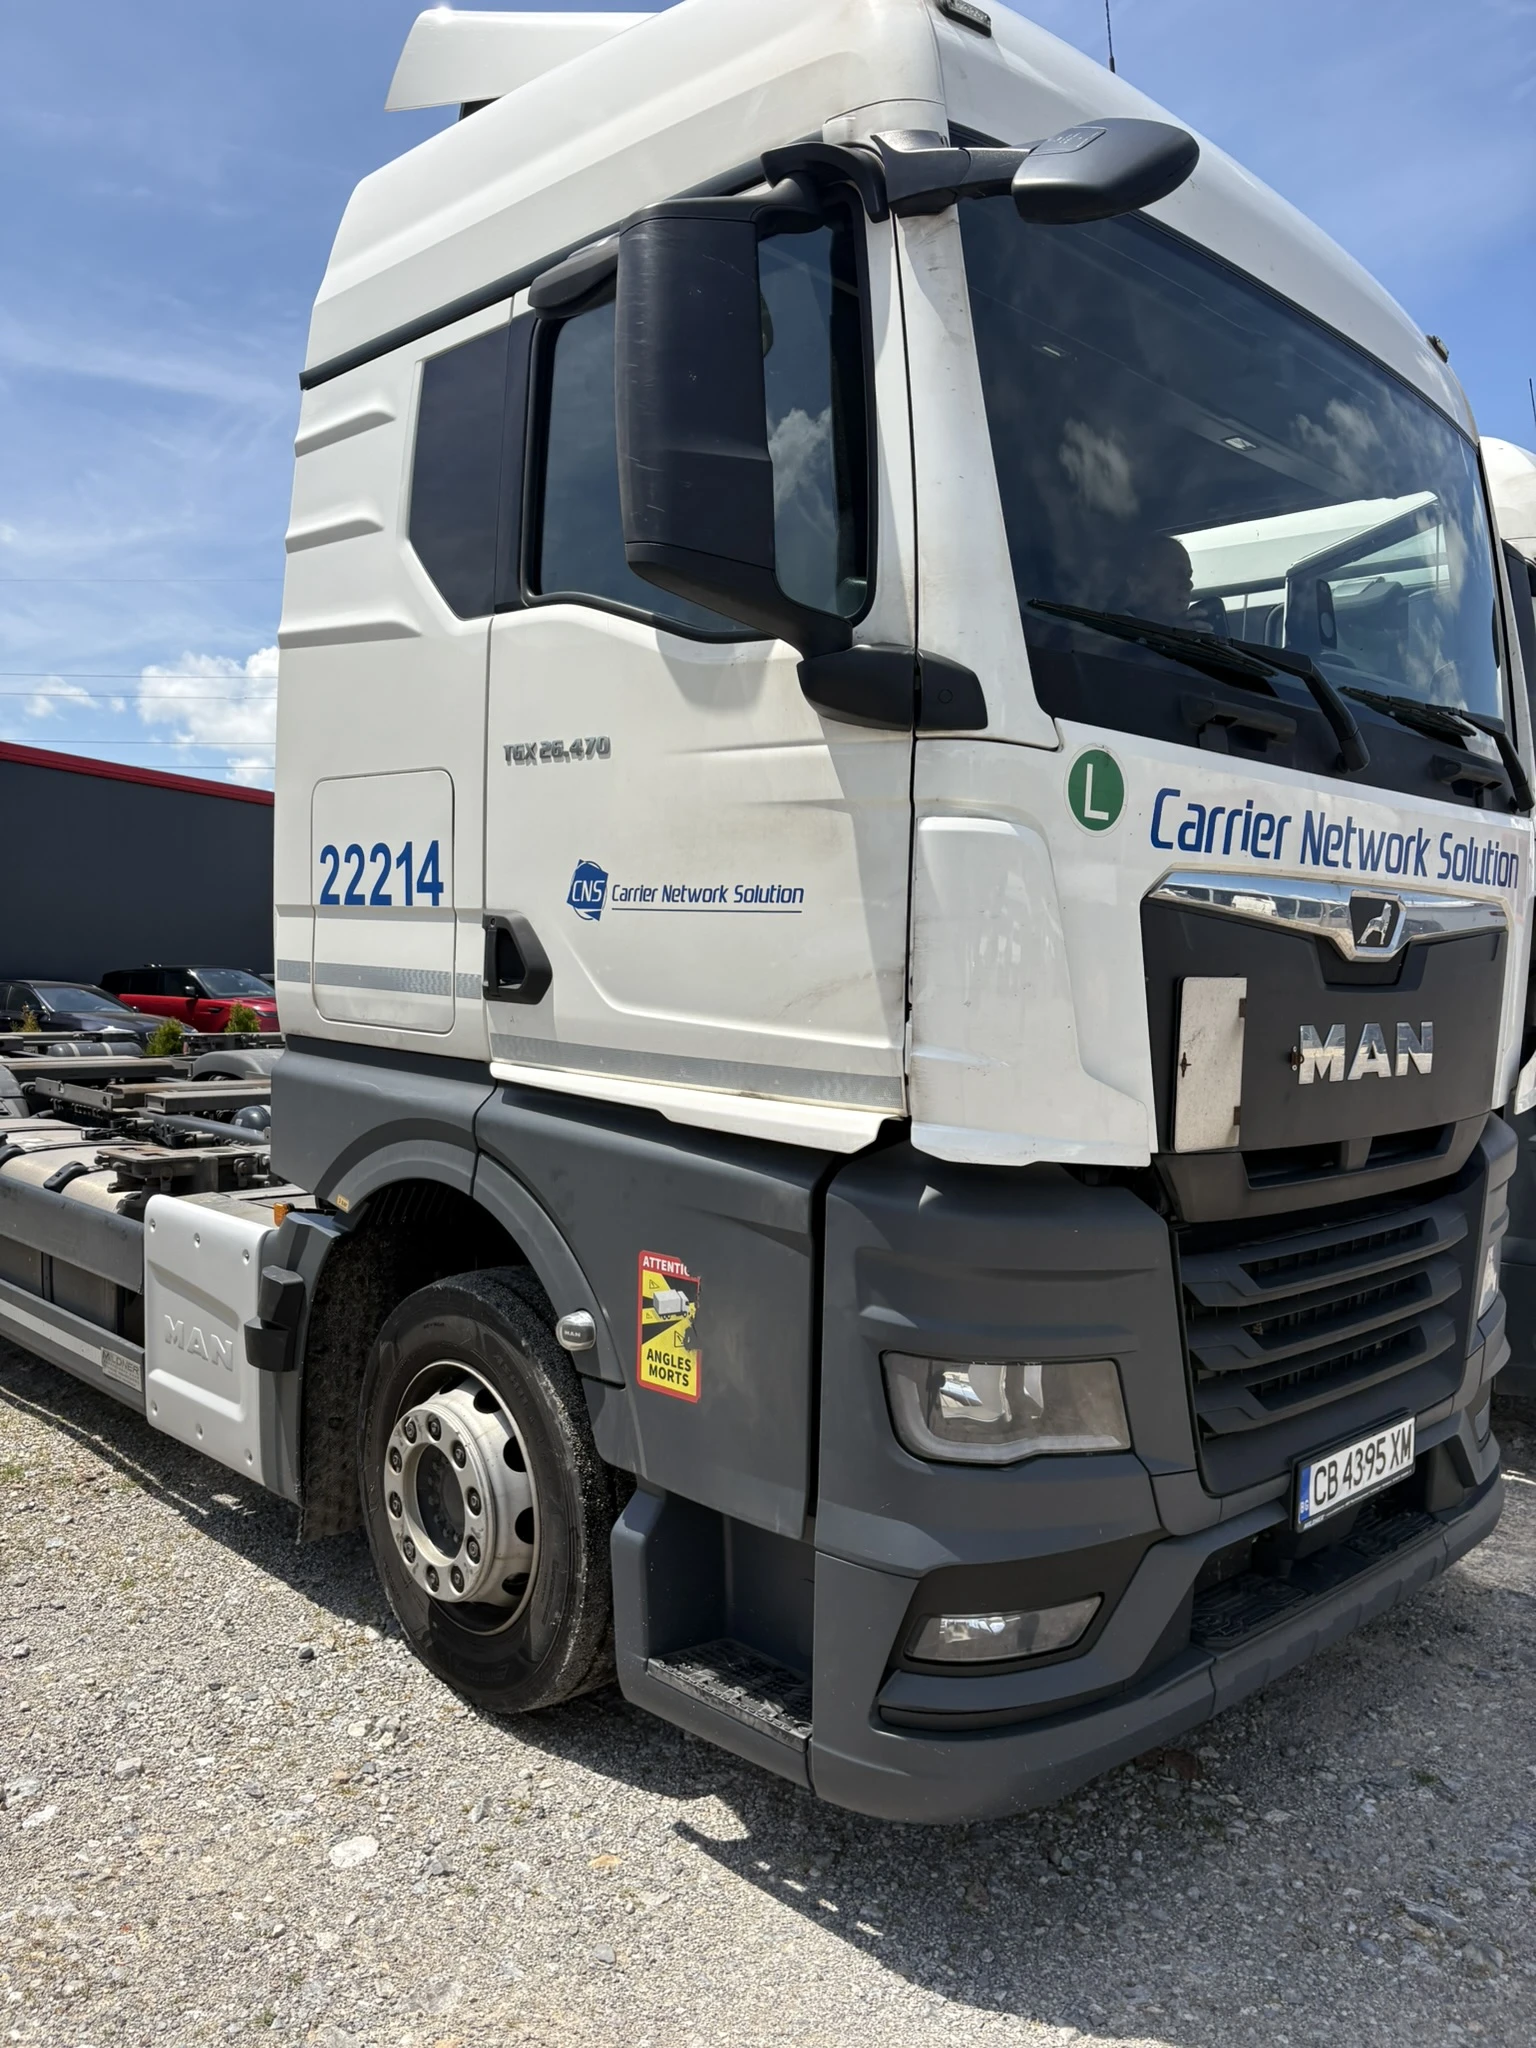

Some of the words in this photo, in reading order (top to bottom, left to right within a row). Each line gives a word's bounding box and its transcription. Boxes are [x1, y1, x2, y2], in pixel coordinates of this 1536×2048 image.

[503, 743, 537, 765] TGX
[539, 736, 611, 763] 26.470
[1084, 763, 1110, 821] L
[1150, 787, 1292, 861] Carrier
[1299, 810, 1431, 877] Network
[1437, 831, 1520, 889] Solution
[319, 840, 445, 907] 22214
[572, 880, 605, 902] CNS
[611, 884, 658, 903] Carrier
[661, 884, 729, 904] Network
[733, 884, 805, 904] Solution
[1299, 1021, 1434, 1085] MAN
[164, 1314, 233, 1372] MAN
[647, 1348, 692, 1372] ANGLES
[649, 1364, 689, 1387] MORTS
[1313, 1459, 1339, 1507] CB
[1342, 1436, 1387, 1491] 4395
[1389, 1424, 1412, 1471] XM
